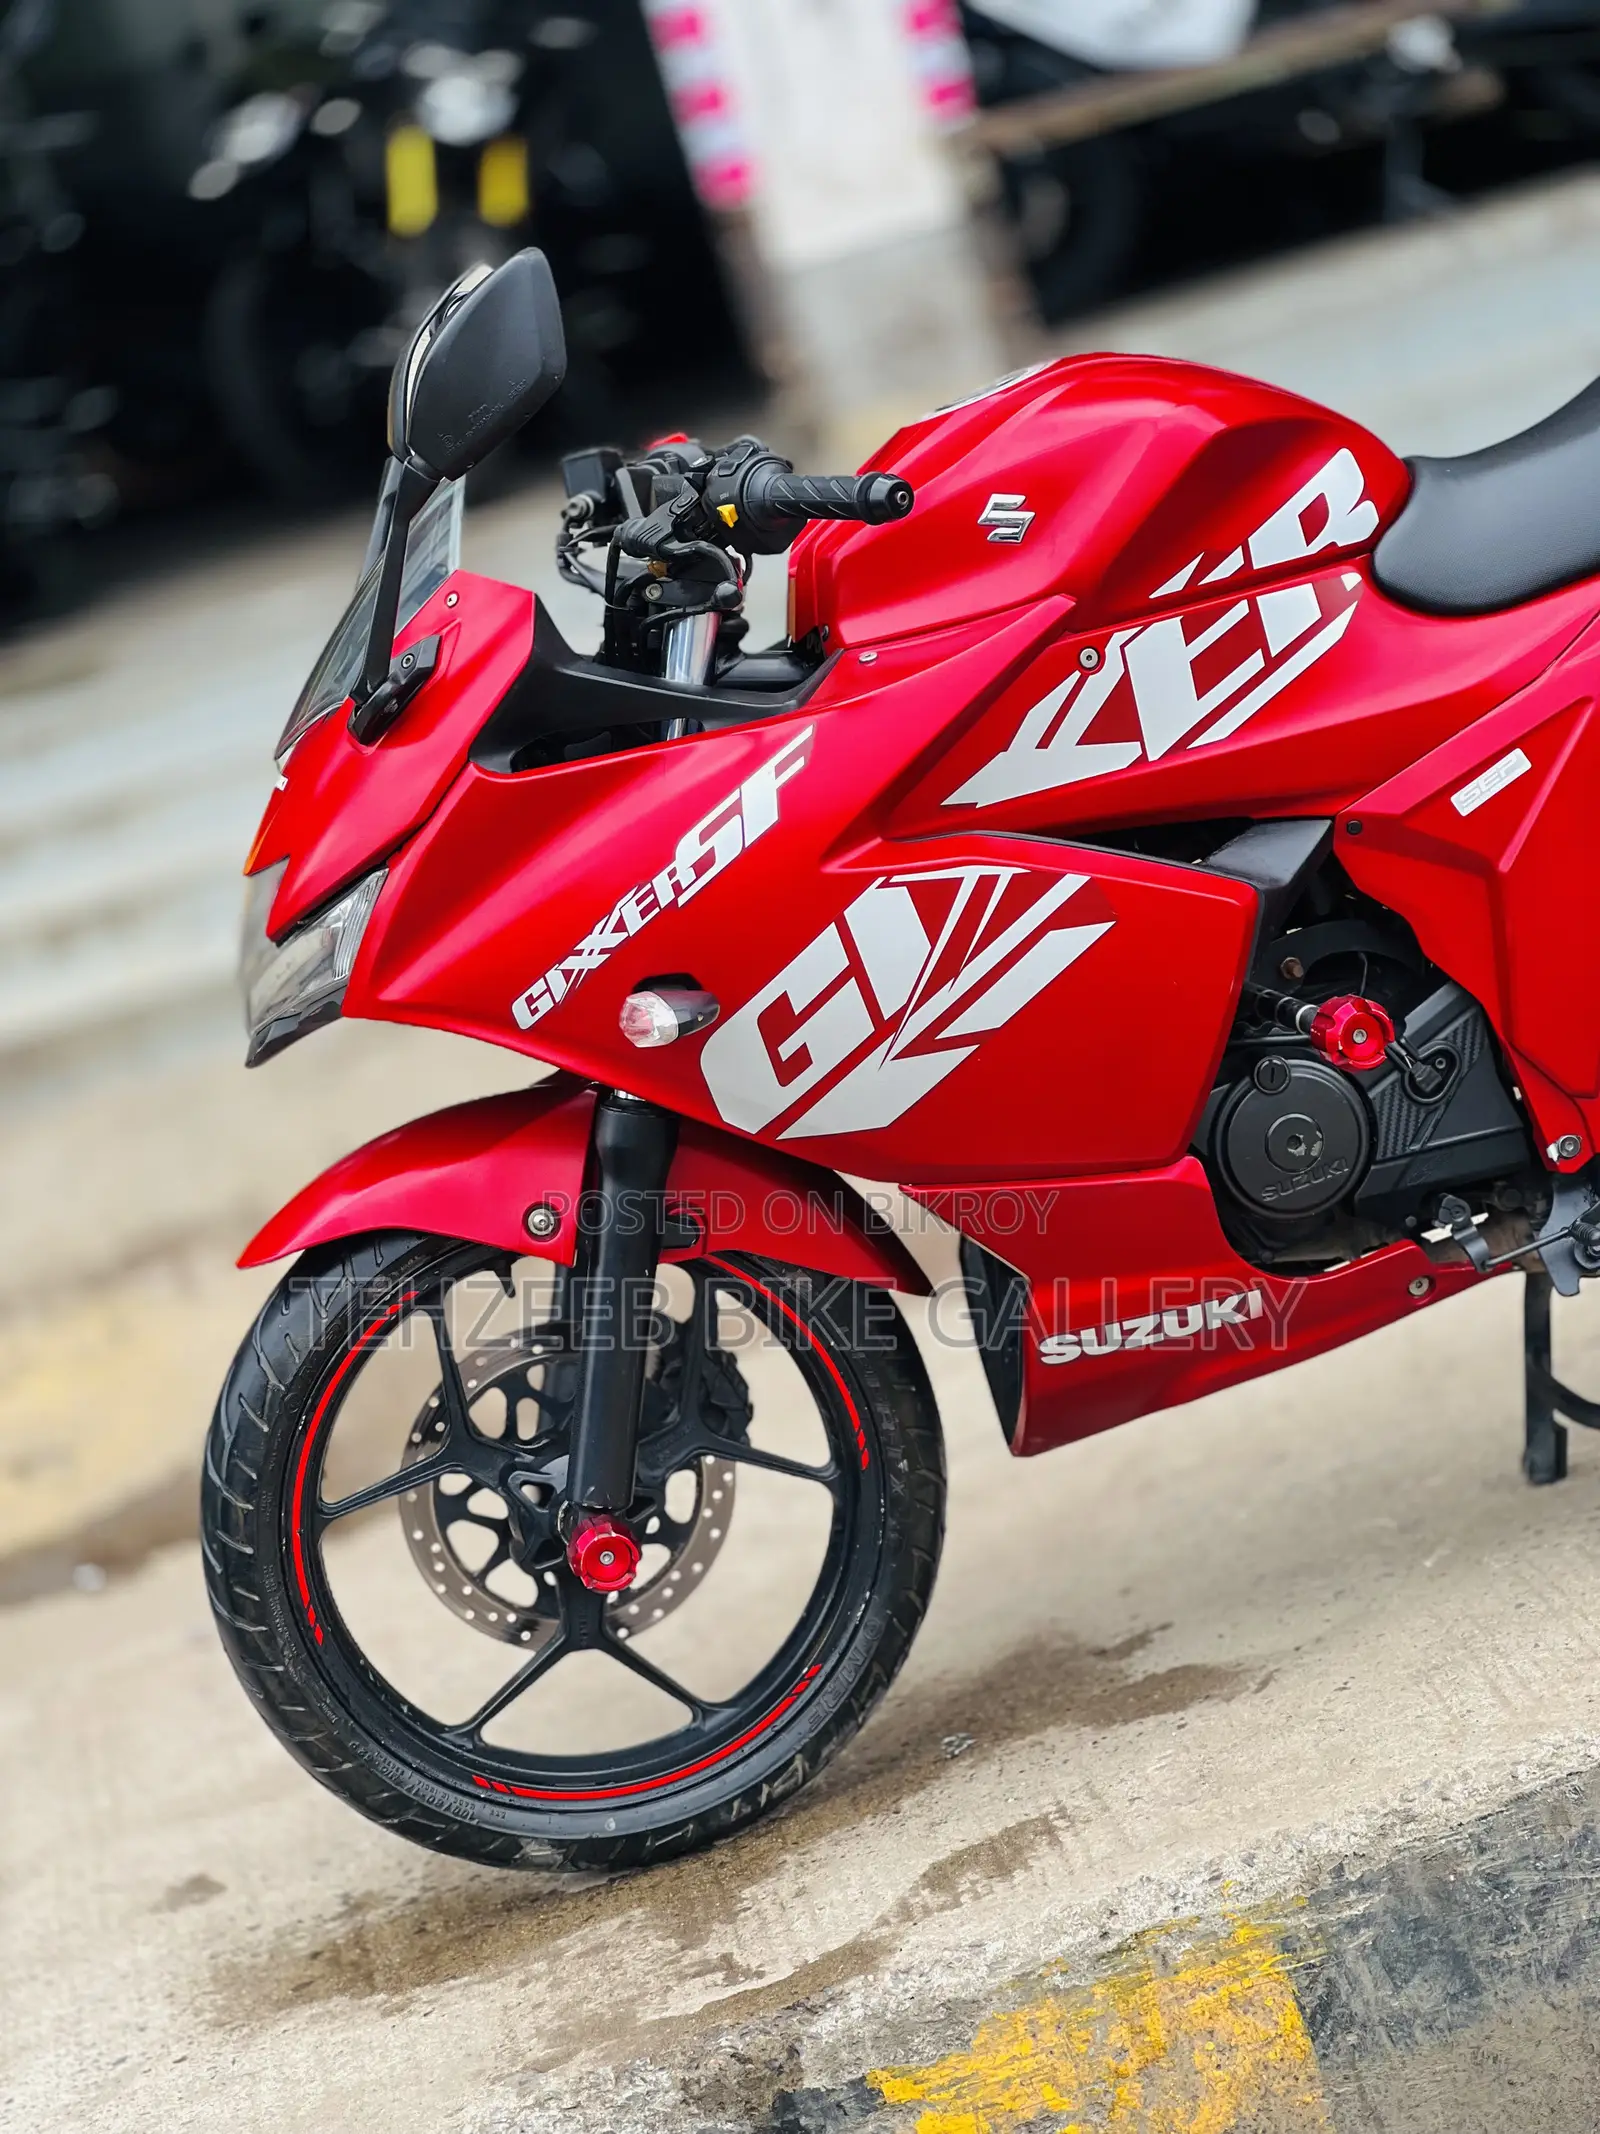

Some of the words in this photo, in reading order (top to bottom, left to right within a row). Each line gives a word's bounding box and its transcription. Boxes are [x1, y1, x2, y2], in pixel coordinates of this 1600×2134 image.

[1459, 753, 1518, 809] SEP
[1262, 1158, 1350, 1202] SUZUKI
[1039, 1288, 1264, 1366] SUZUKI
